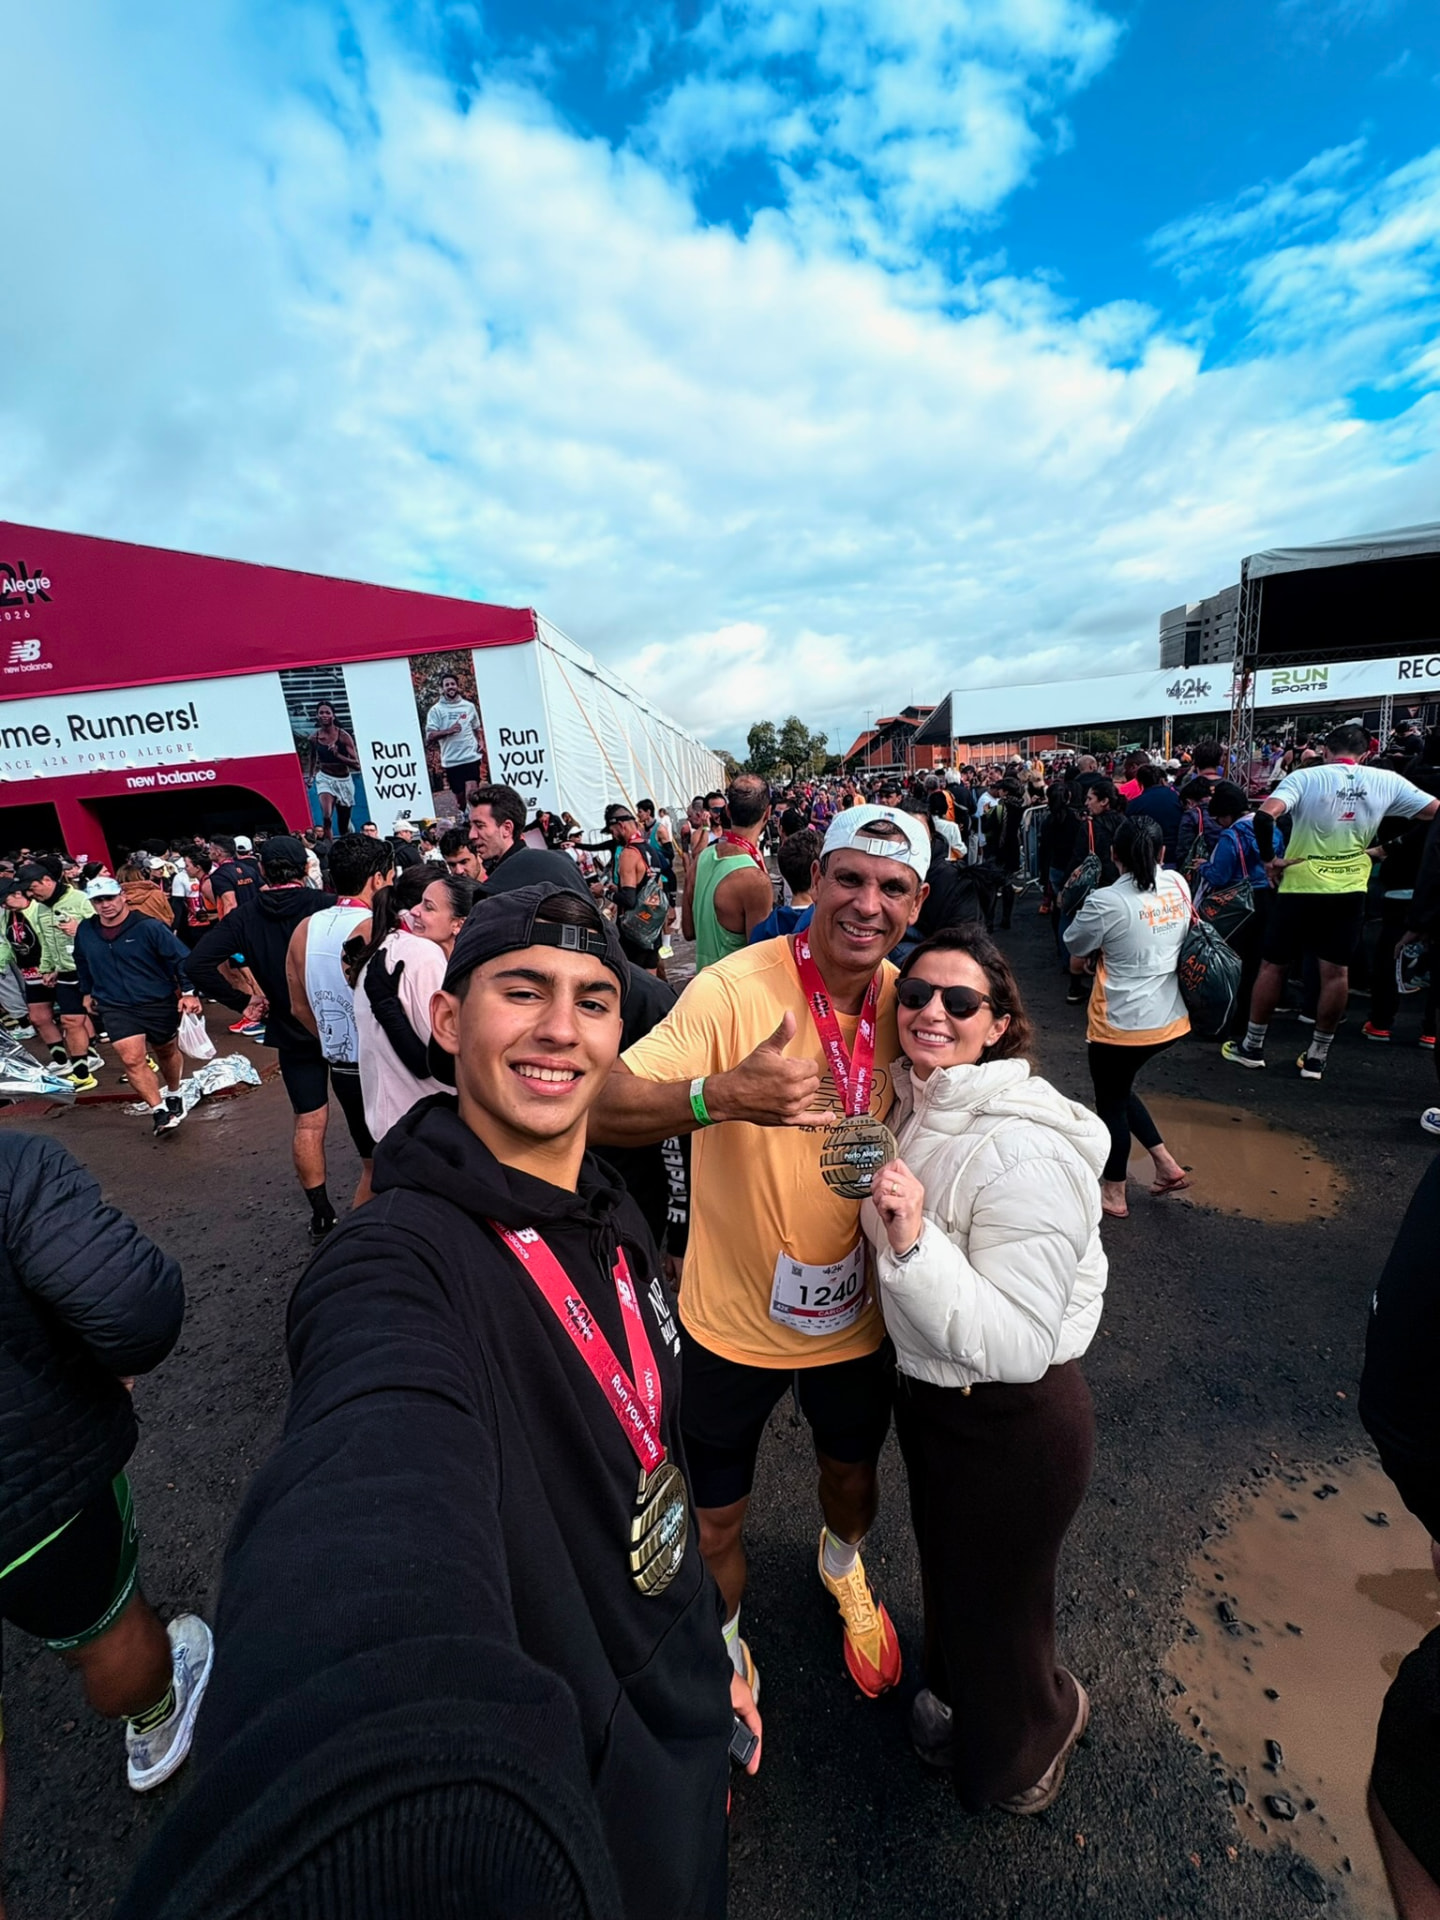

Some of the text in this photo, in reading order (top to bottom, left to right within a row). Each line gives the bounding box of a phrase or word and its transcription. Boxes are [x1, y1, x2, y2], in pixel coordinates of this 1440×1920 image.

[2, 577, 51, 594] Alegre
[0, 610, 31, 621] 026
[20, 662, 53, 672] balance
[1271, 667, 1328, 685] RUN
[1271, 682, 1328, 694] SPORTS
[0, 702, 199, 748] me, Runners!
[499, 728, 539, 747] Run
[42, 757, 68, 767] 42K
[79, 750, 127, 763] PORTO
[137, 743, 194, 757] ALEGRE
[371, 741, 412, 760] Run
[498, 749, 545, 772] your
[126, 769, 216, 788] new balance
[371, 762, 417, 784] your
[500, 769, 549, 788] way.
[374, 783, 422, 801] way.
[829, 1041, 840, 1056] Run
[834, 1057, 847, 1075] your
[514, 1226, 539, 1244] B
[799, 1272, 857, 1306] 1240
[643, 1368, 655, 1401] way.
[611, 1374, 628, 1402] Run
[625, 1400, 644, 1431] your
[643, 1429, 659, 1462] way.
